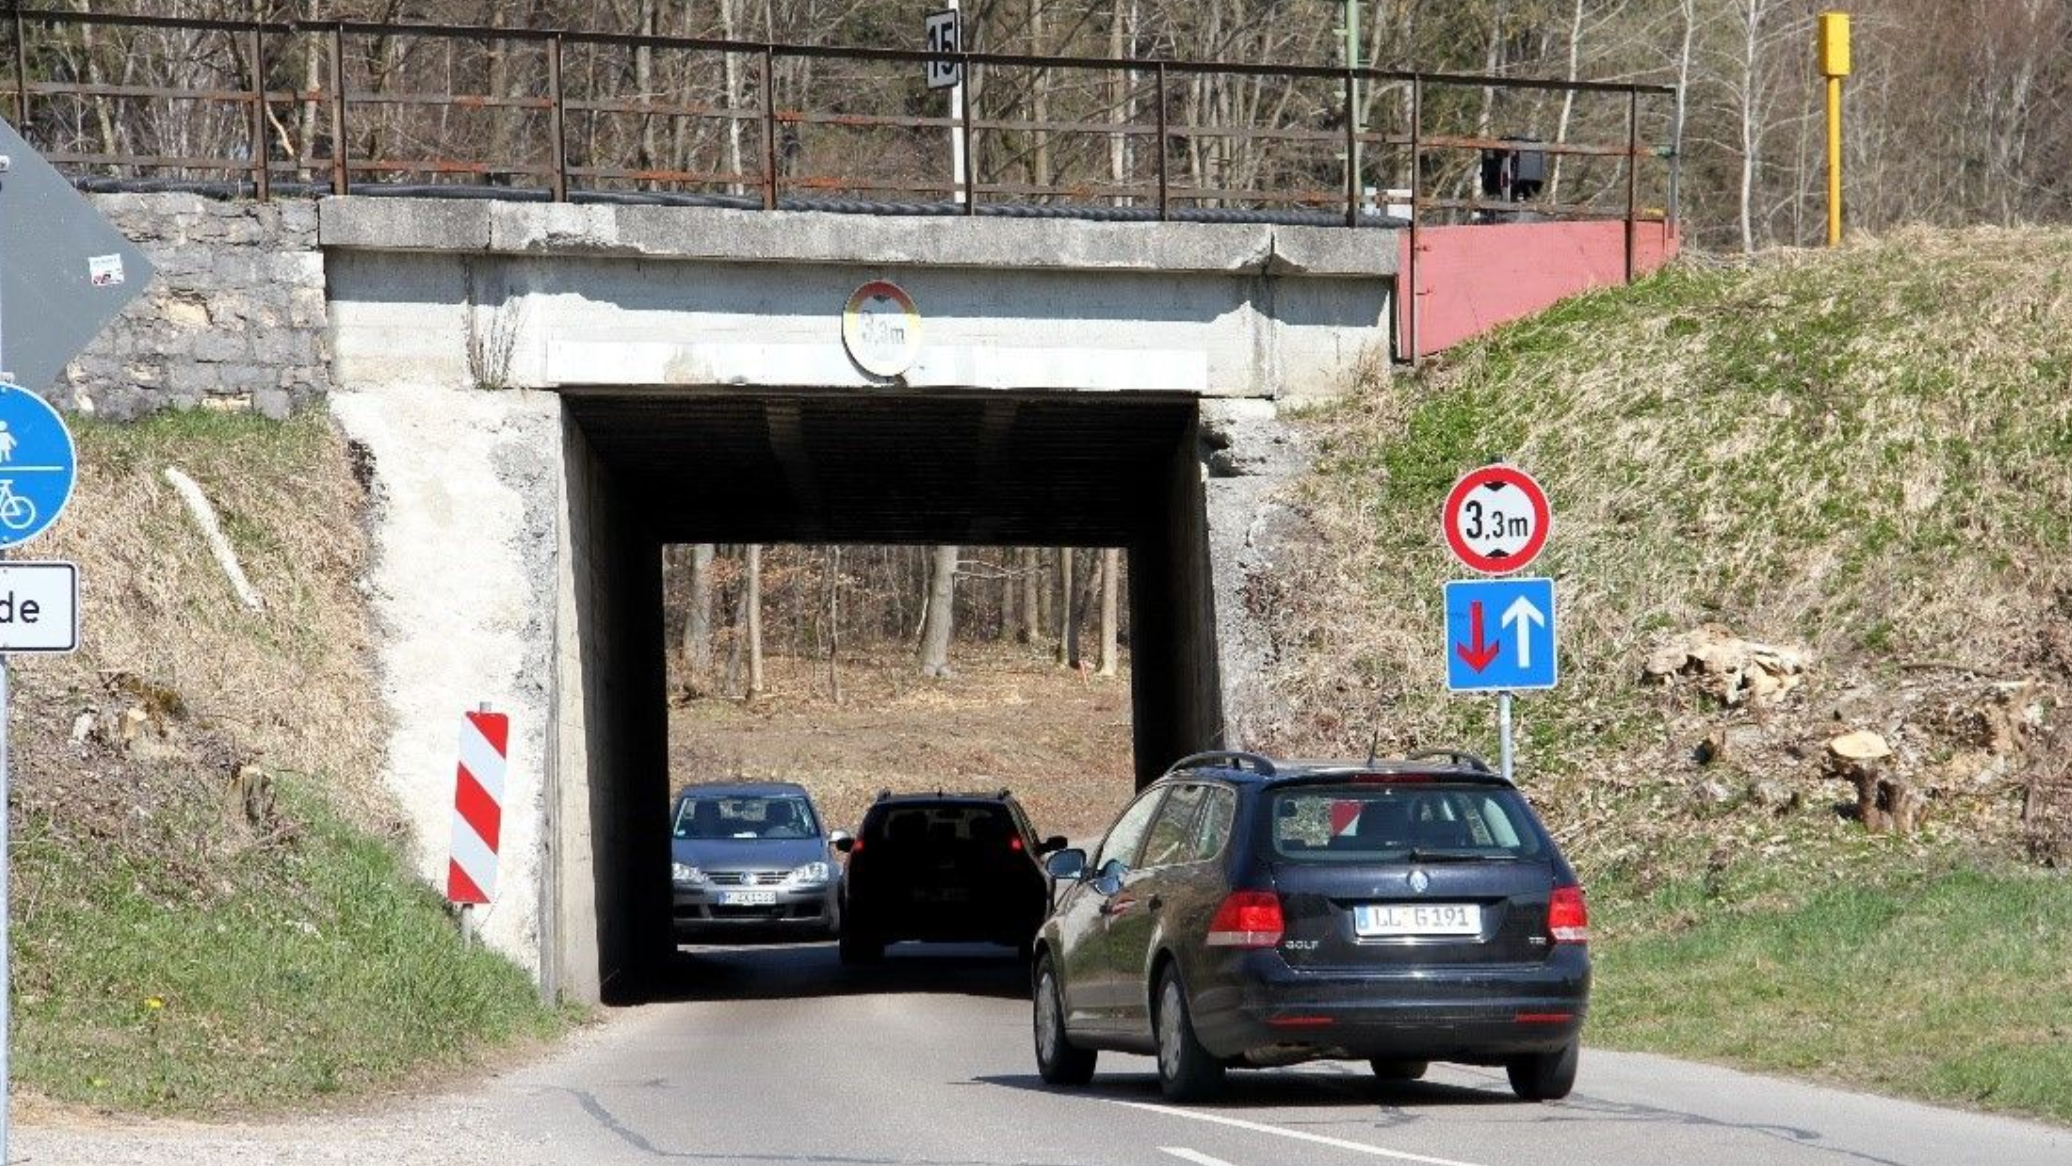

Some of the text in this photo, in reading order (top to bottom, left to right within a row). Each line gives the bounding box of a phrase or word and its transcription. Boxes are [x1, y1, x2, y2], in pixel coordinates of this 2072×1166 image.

[929, 21, 955, 79] 15
[1465, 499, 1529, 541] 3,3m
[0, 590, 40, 623] de
[1285, 940, 1319, 950] GOLF
